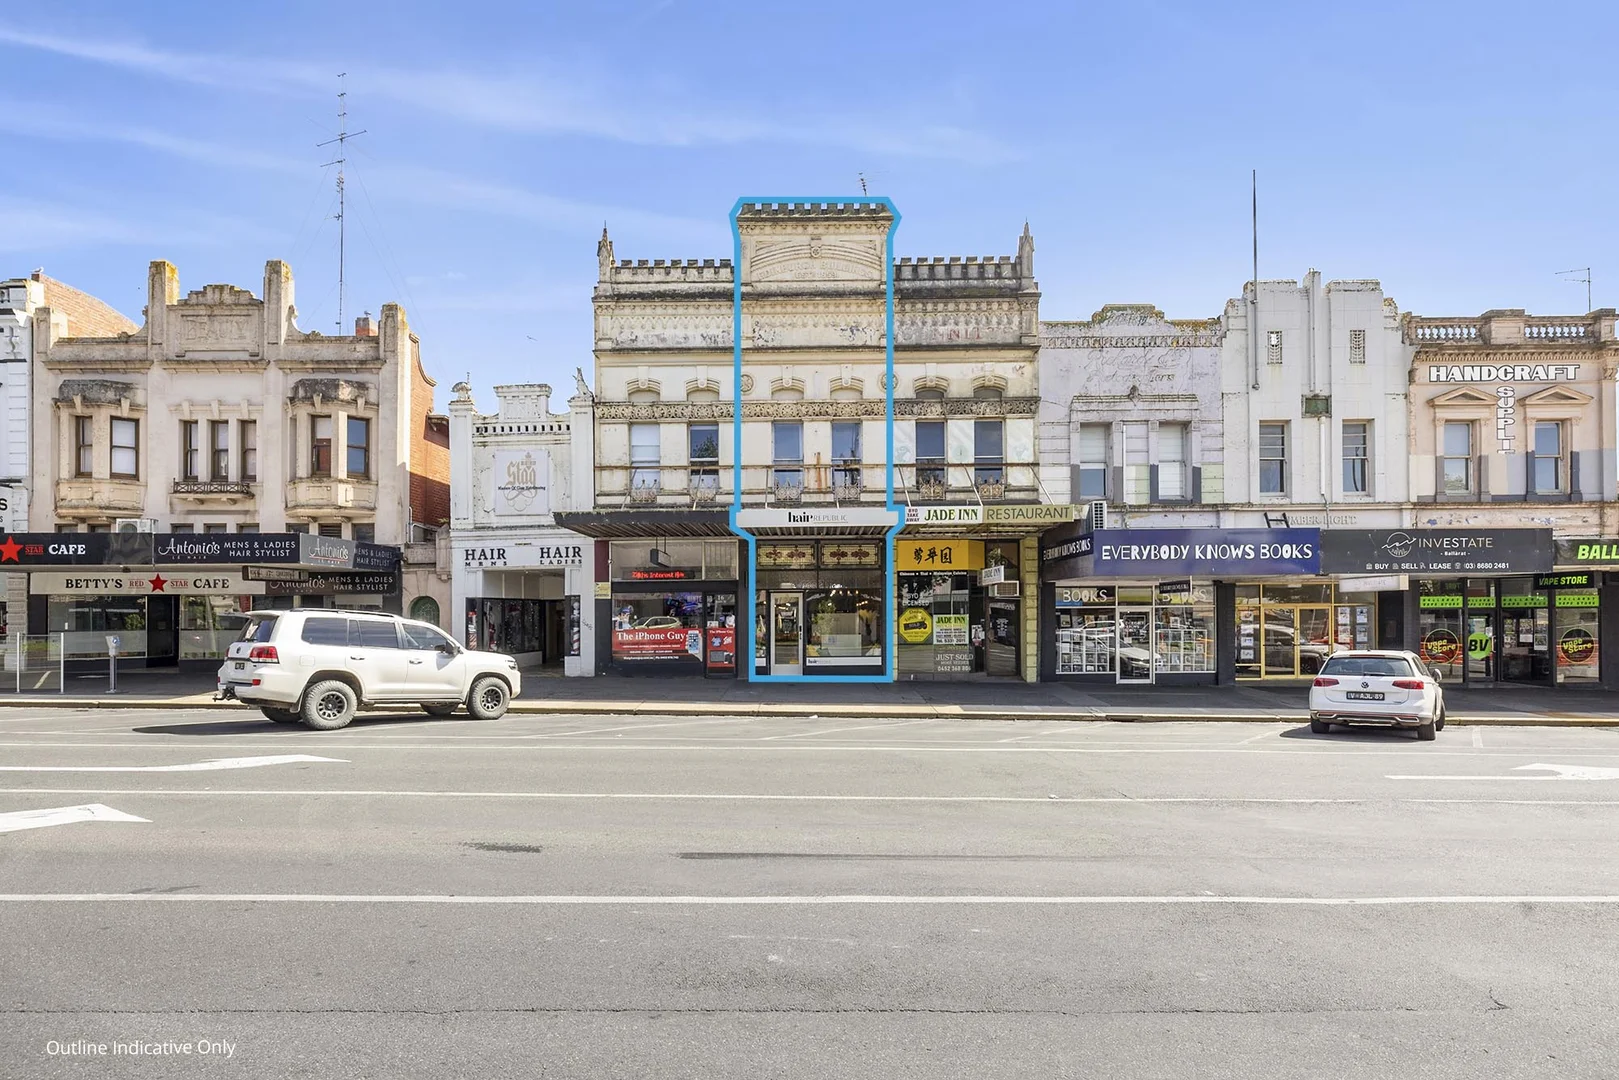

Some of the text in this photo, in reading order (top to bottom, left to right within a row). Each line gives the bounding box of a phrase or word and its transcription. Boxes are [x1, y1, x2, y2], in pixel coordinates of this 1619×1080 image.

[1429, 365, 1580, 382] HANDCRAFT
[788, 512, 813, 522] hair
[924, 509, 978, 521] JADE INN
[986, 507, 1070, 520] RESTAURANT
[158, 538, 220, 556] Antonio's
[309, 538, 349, 560] Antonio's
[376, 550, 393, 558] LADIES
[1418, 538, 1493, 548] INVESTATE
[25, 544, 86, 555] STAR CAFE
[464, 548, 506, 560] HAIR
[540, 546, 582, 558] HAIR
[1102, 544, 1312, 560] EVERYBODY KNOWS BOOKS
[1578, 544, 1619, 560] BALL
[371, 558, 390, 566] STYLIST
[66, 578, 122, 589] BETTY'S
[193, 578, 230, 589] CAFE
[1539, 576, 1588, 586] VAPE STORE
[1063, 590, 1108, 602] BOOKS
[616, 632, 686, 642] The iPhone Guy
[1468, 639, 1489, 652] BV
